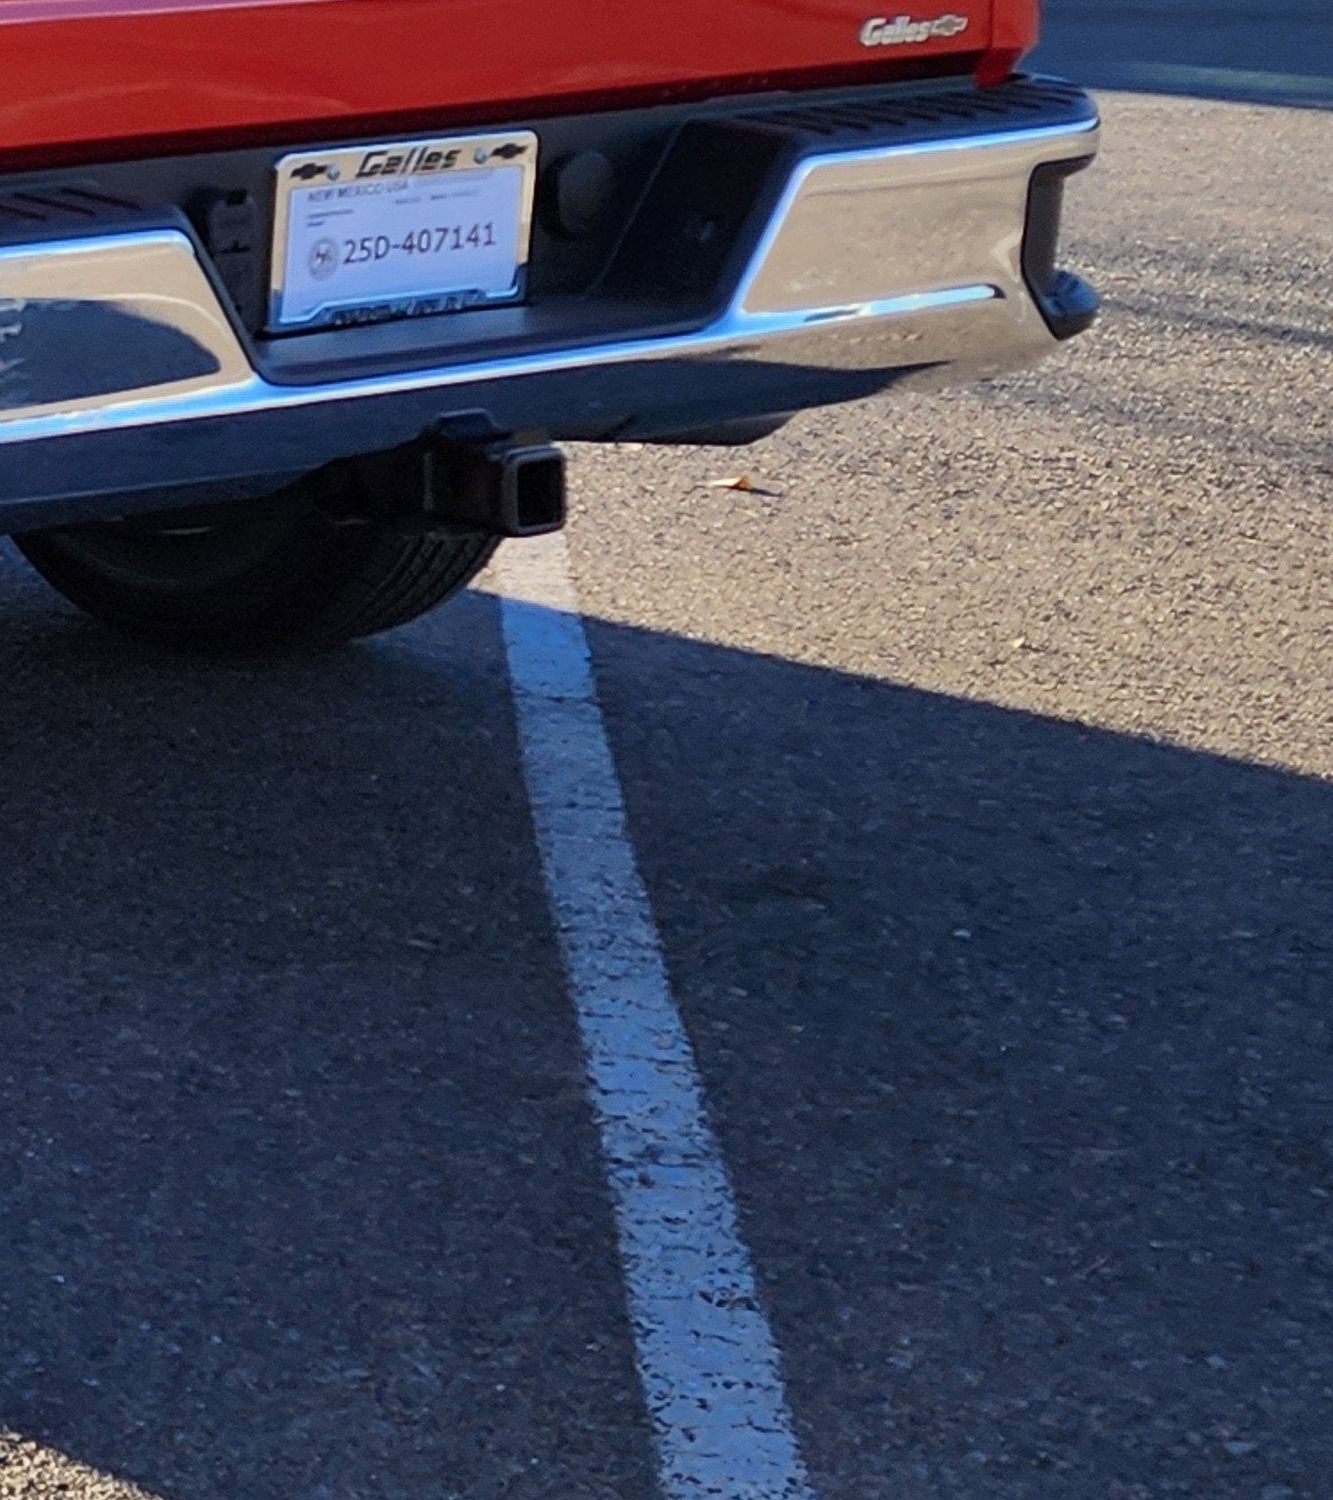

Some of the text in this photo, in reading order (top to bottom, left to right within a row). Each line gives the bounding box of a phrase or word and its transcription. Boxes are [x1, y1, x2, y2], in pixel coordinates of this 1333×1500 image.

[859, 15, 932, 47] Galles
[354, 147, 463, 179] Galles
[342, 221, 498, 265] 25D-407141
